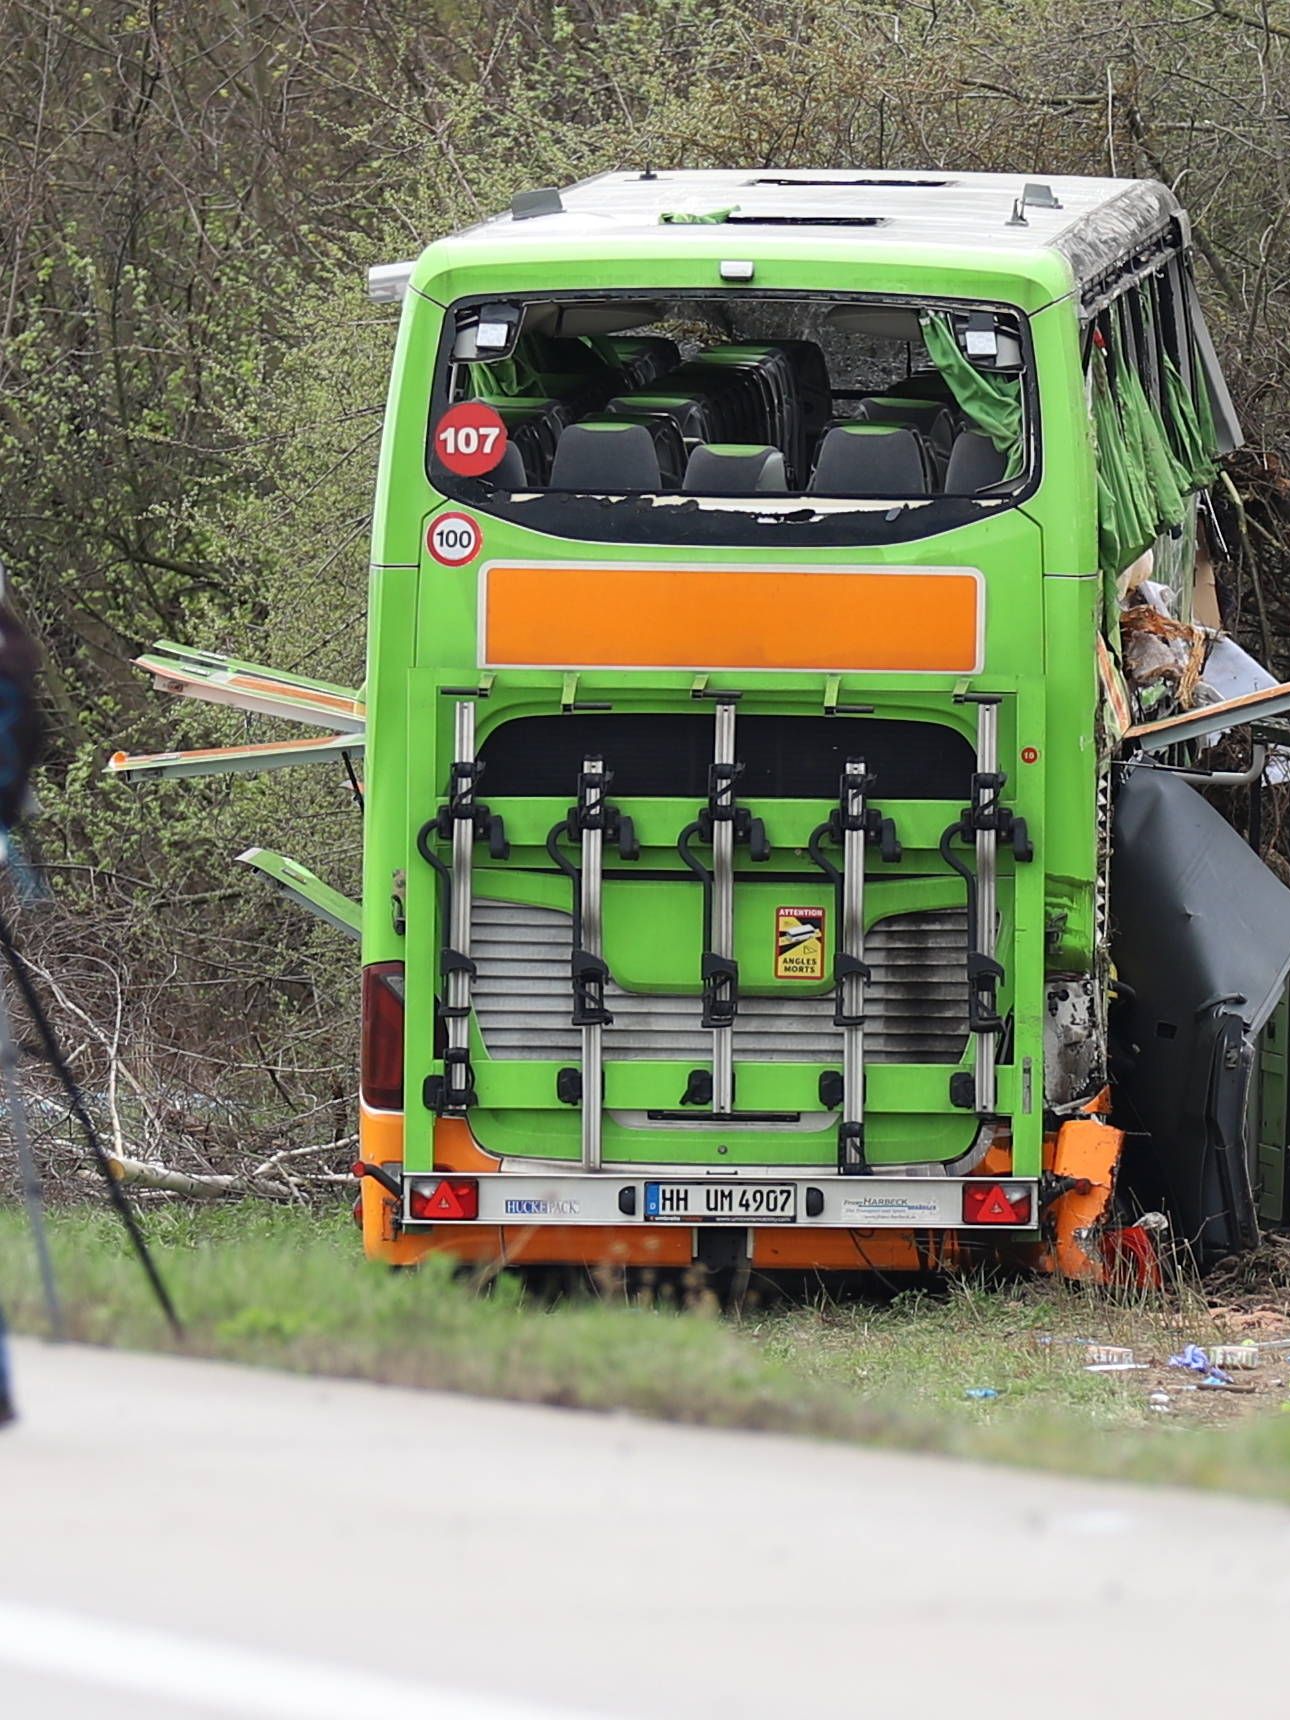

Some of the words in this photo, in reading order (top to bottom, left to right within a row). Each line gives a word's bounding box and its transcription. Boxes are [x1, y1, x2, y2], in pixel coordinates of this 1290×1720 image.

[439, 427, 501, 454] 107
[436, 530, 472, 549] 100
[784, 965, 815, 973] MORTS
[661, 1189, 688, 1212] HH
[706, 1189, 733, 1212] UM
[738, 1189, 792, 1212] 4907
